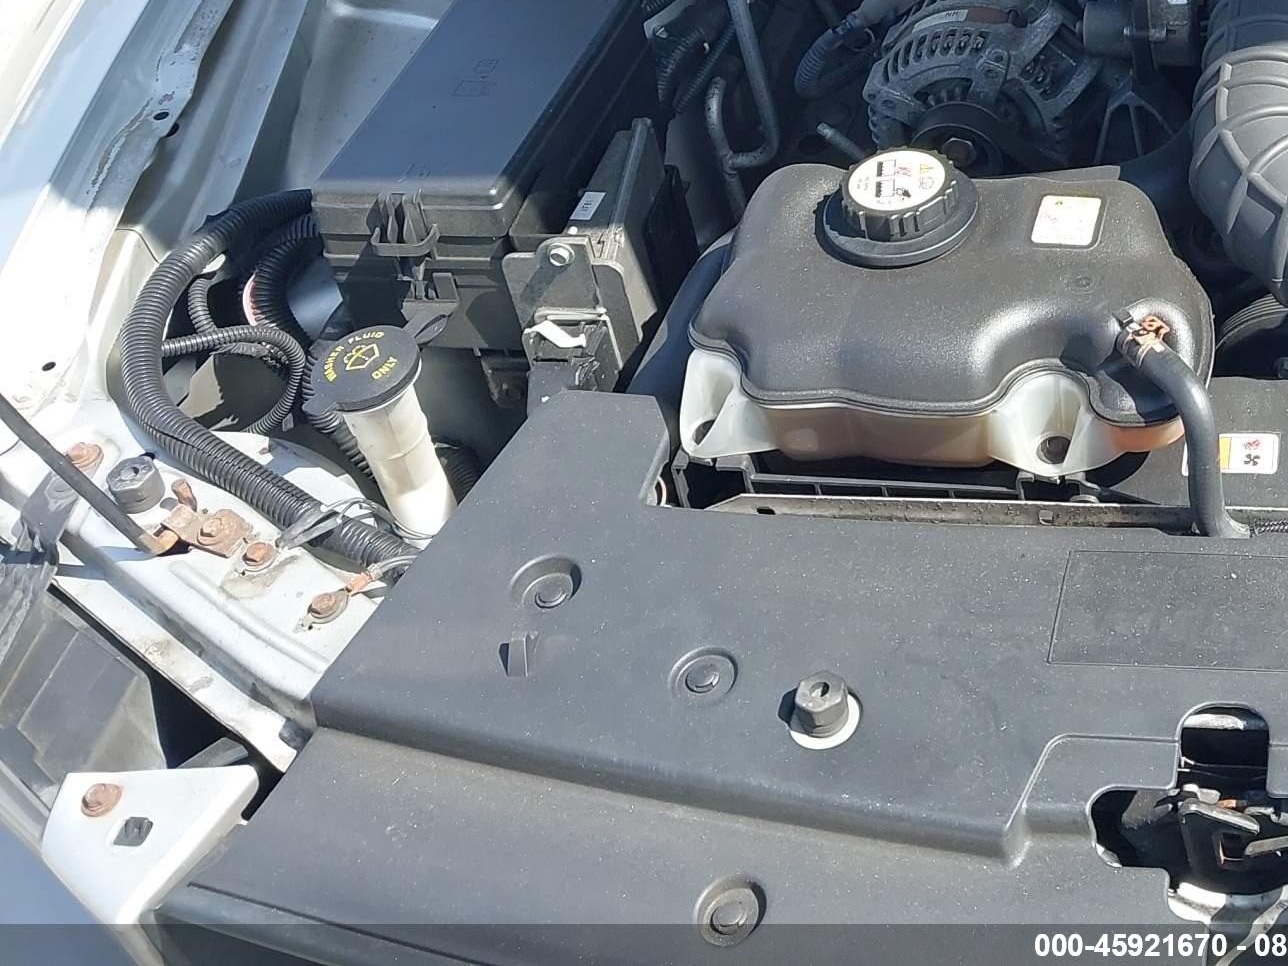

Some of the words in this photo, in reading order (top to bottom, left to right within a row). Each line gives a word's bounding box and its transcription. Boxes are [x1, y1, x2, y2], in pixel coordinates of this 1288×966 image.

[324, 346, 344, 382] WASHER
[348, 330, 385, 344] FLUID
[371, 356, 398, 380] ONLY
